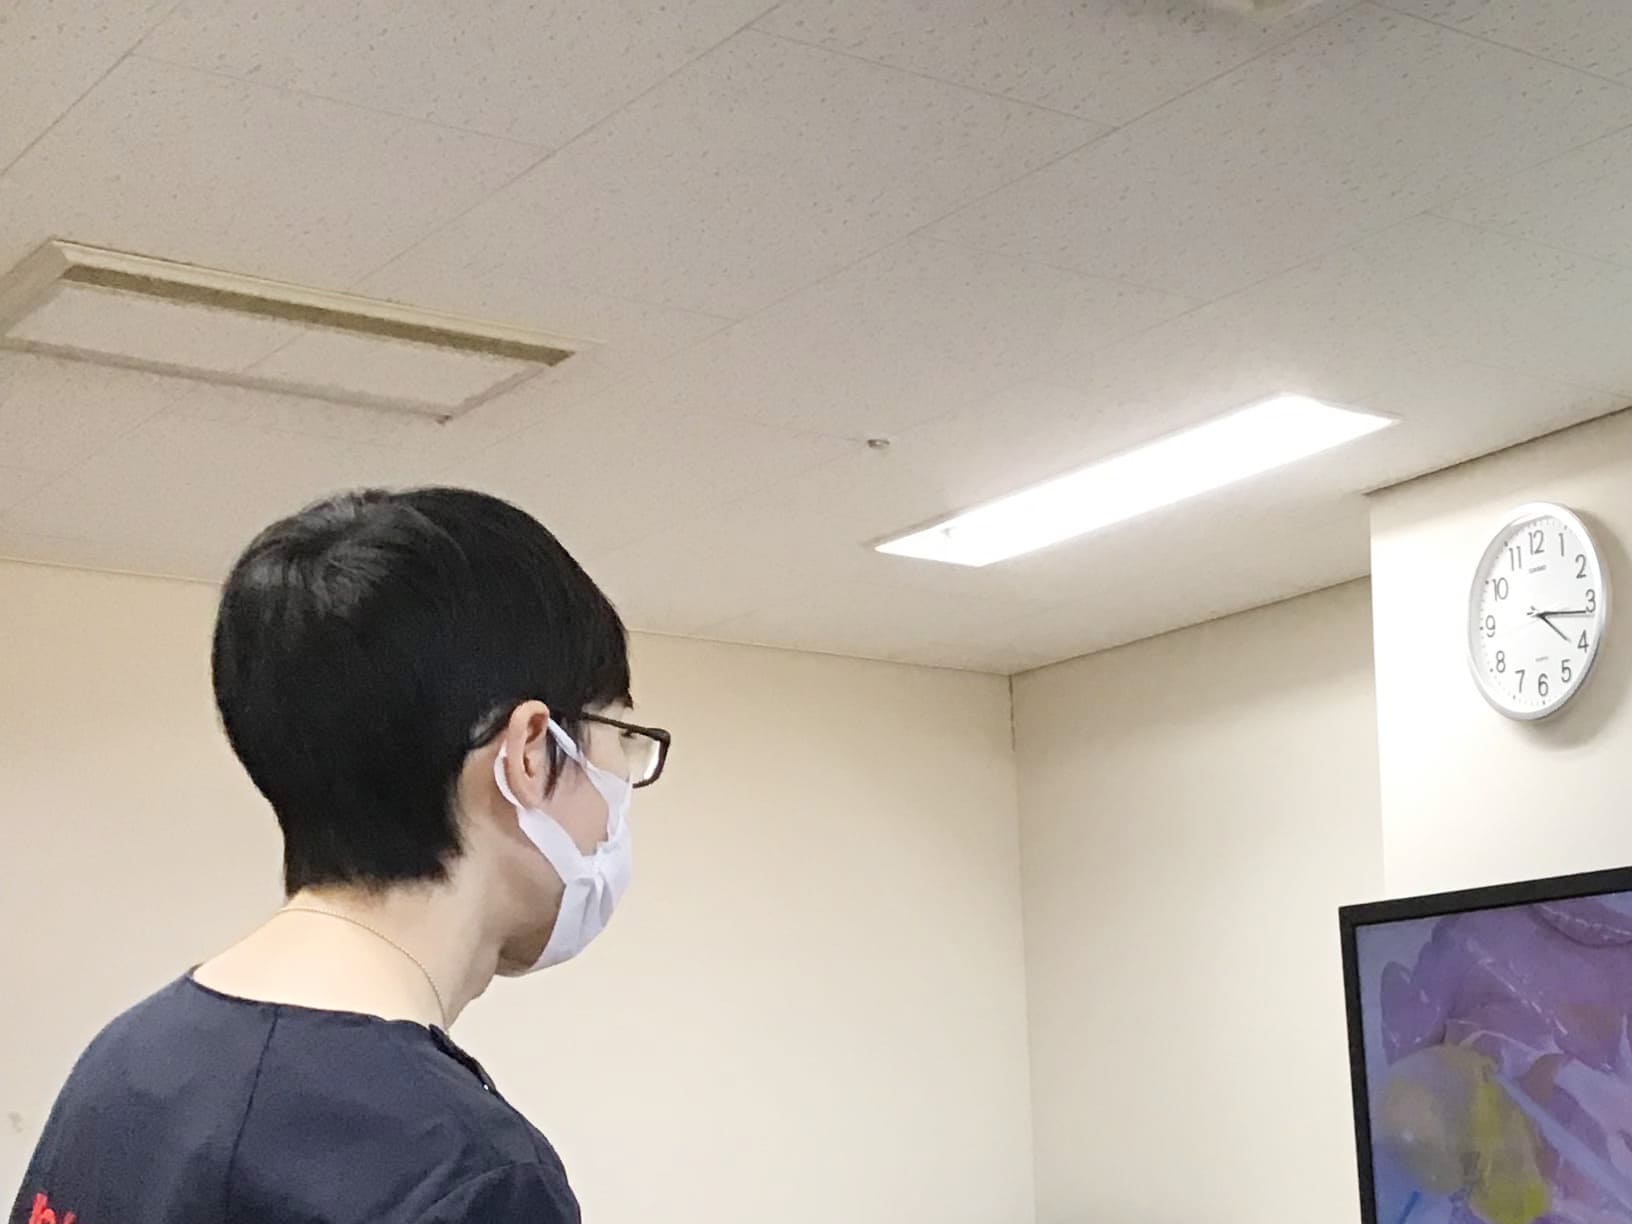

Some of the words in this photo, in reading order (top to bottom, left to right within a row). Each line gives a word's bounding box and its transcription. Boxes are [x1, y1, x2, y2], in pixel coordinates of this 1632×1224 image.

[1528, 530, 1545, 556] 12
[1558, 533, 1565, 556] 1
[1508, 546, 1522, 571] 11
[1575, 554, 1587, 579] 2
[1492, 577, 1508, 601] 10
[1585, 589, 1596, 613] 3
[1485, 615, 1496, 638] 9
[1577, 630, 1589, 653] 4
[1495, 650, 1506, 673] 8
[1561, 659, 1572, 683] 5
[1515, 669, 1525, 693] 7
[1537, 673, 1549, 697] 6
